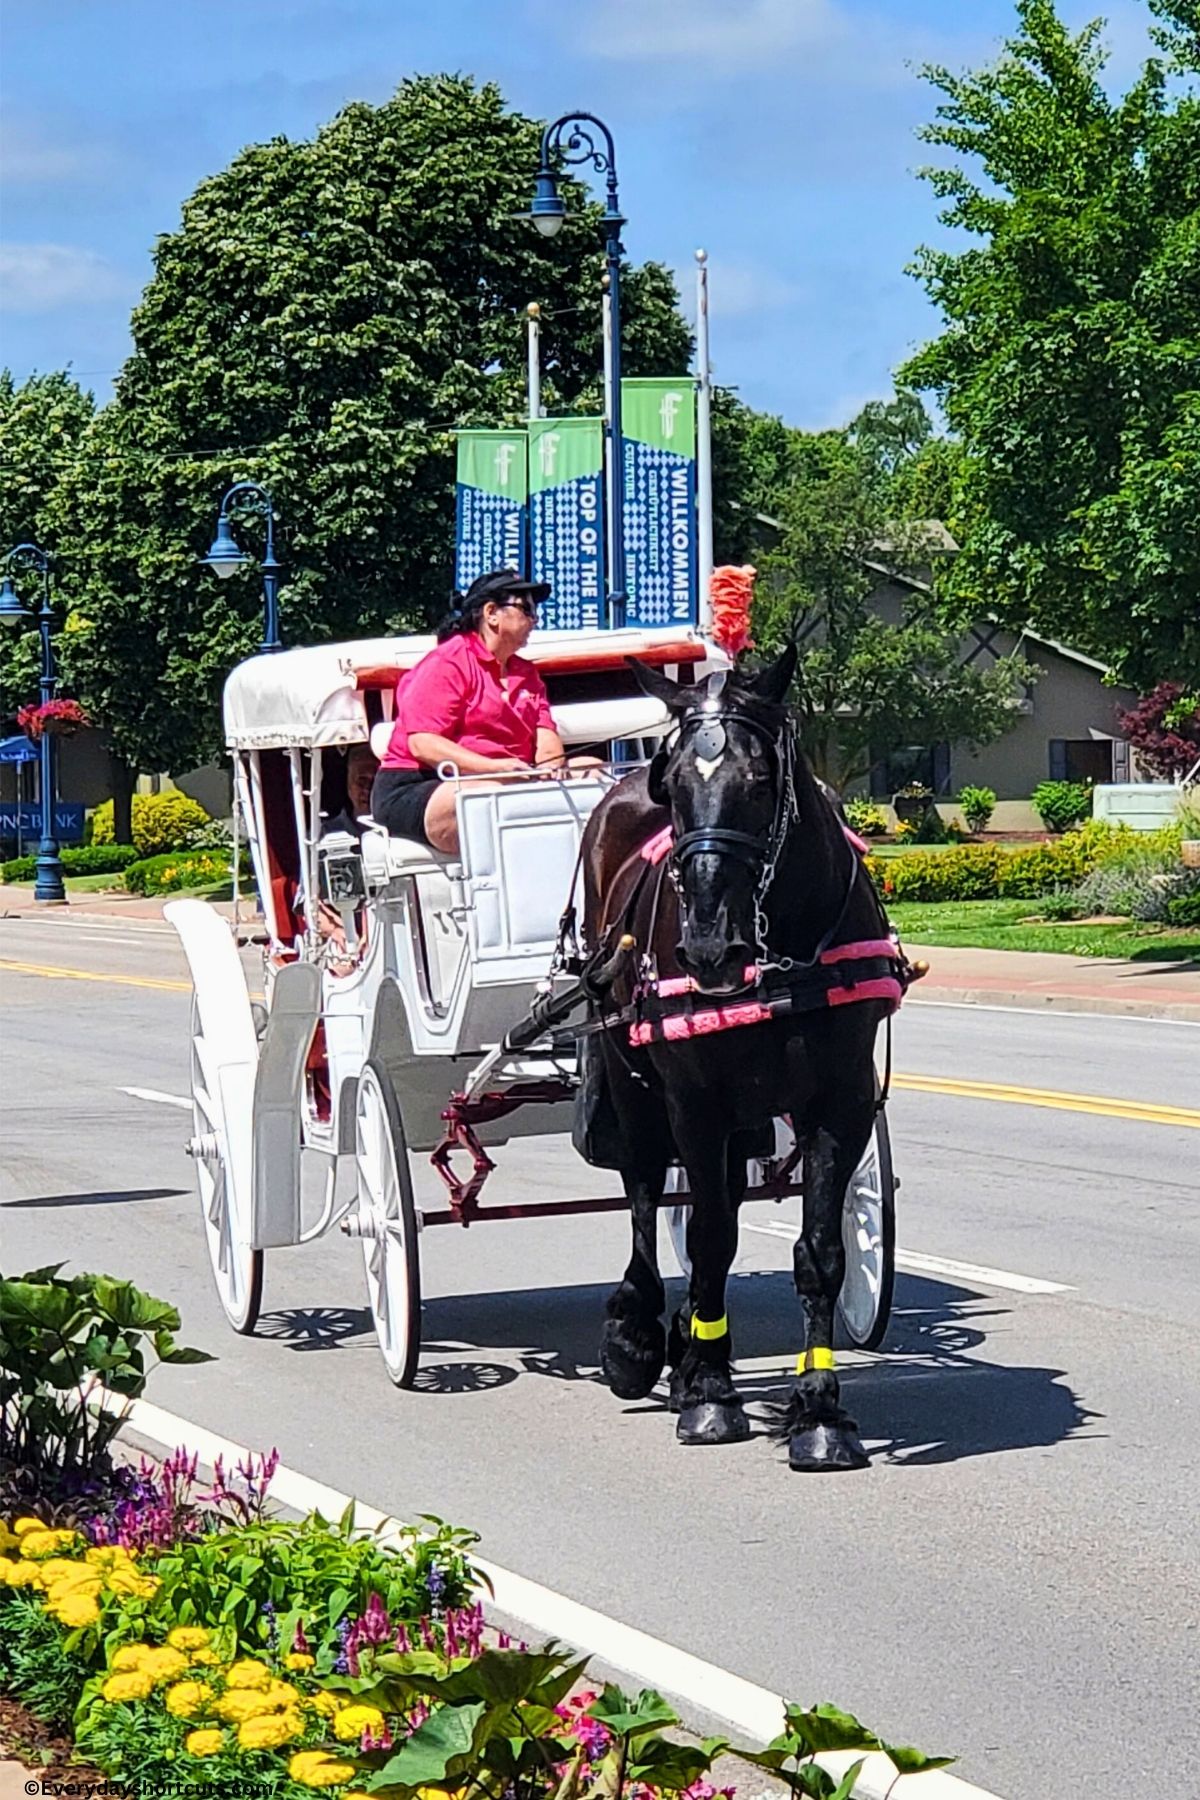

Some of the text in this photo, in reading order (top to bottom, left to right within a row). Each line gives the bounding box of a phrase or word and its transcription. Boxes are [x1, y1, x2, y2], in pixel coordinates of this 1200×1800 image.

[625, 443, 636, 500] CULTURE
[462, 489, 472, 540] CULTURE
[544, 495, 554, 524] DINE
[580, 481, 597, 521] TOP
[504, 512, 520, 571] WILLK
[545, 531, 555, 562] SHOP
[580, 527, 597, 556] OF
[671, 467, 689, 618] WILLKOMMEN
[581, 560, 598, 597] THE
[625, 554, 637, 618] HISTORIC
[546, 608, 556, 630] PLA
